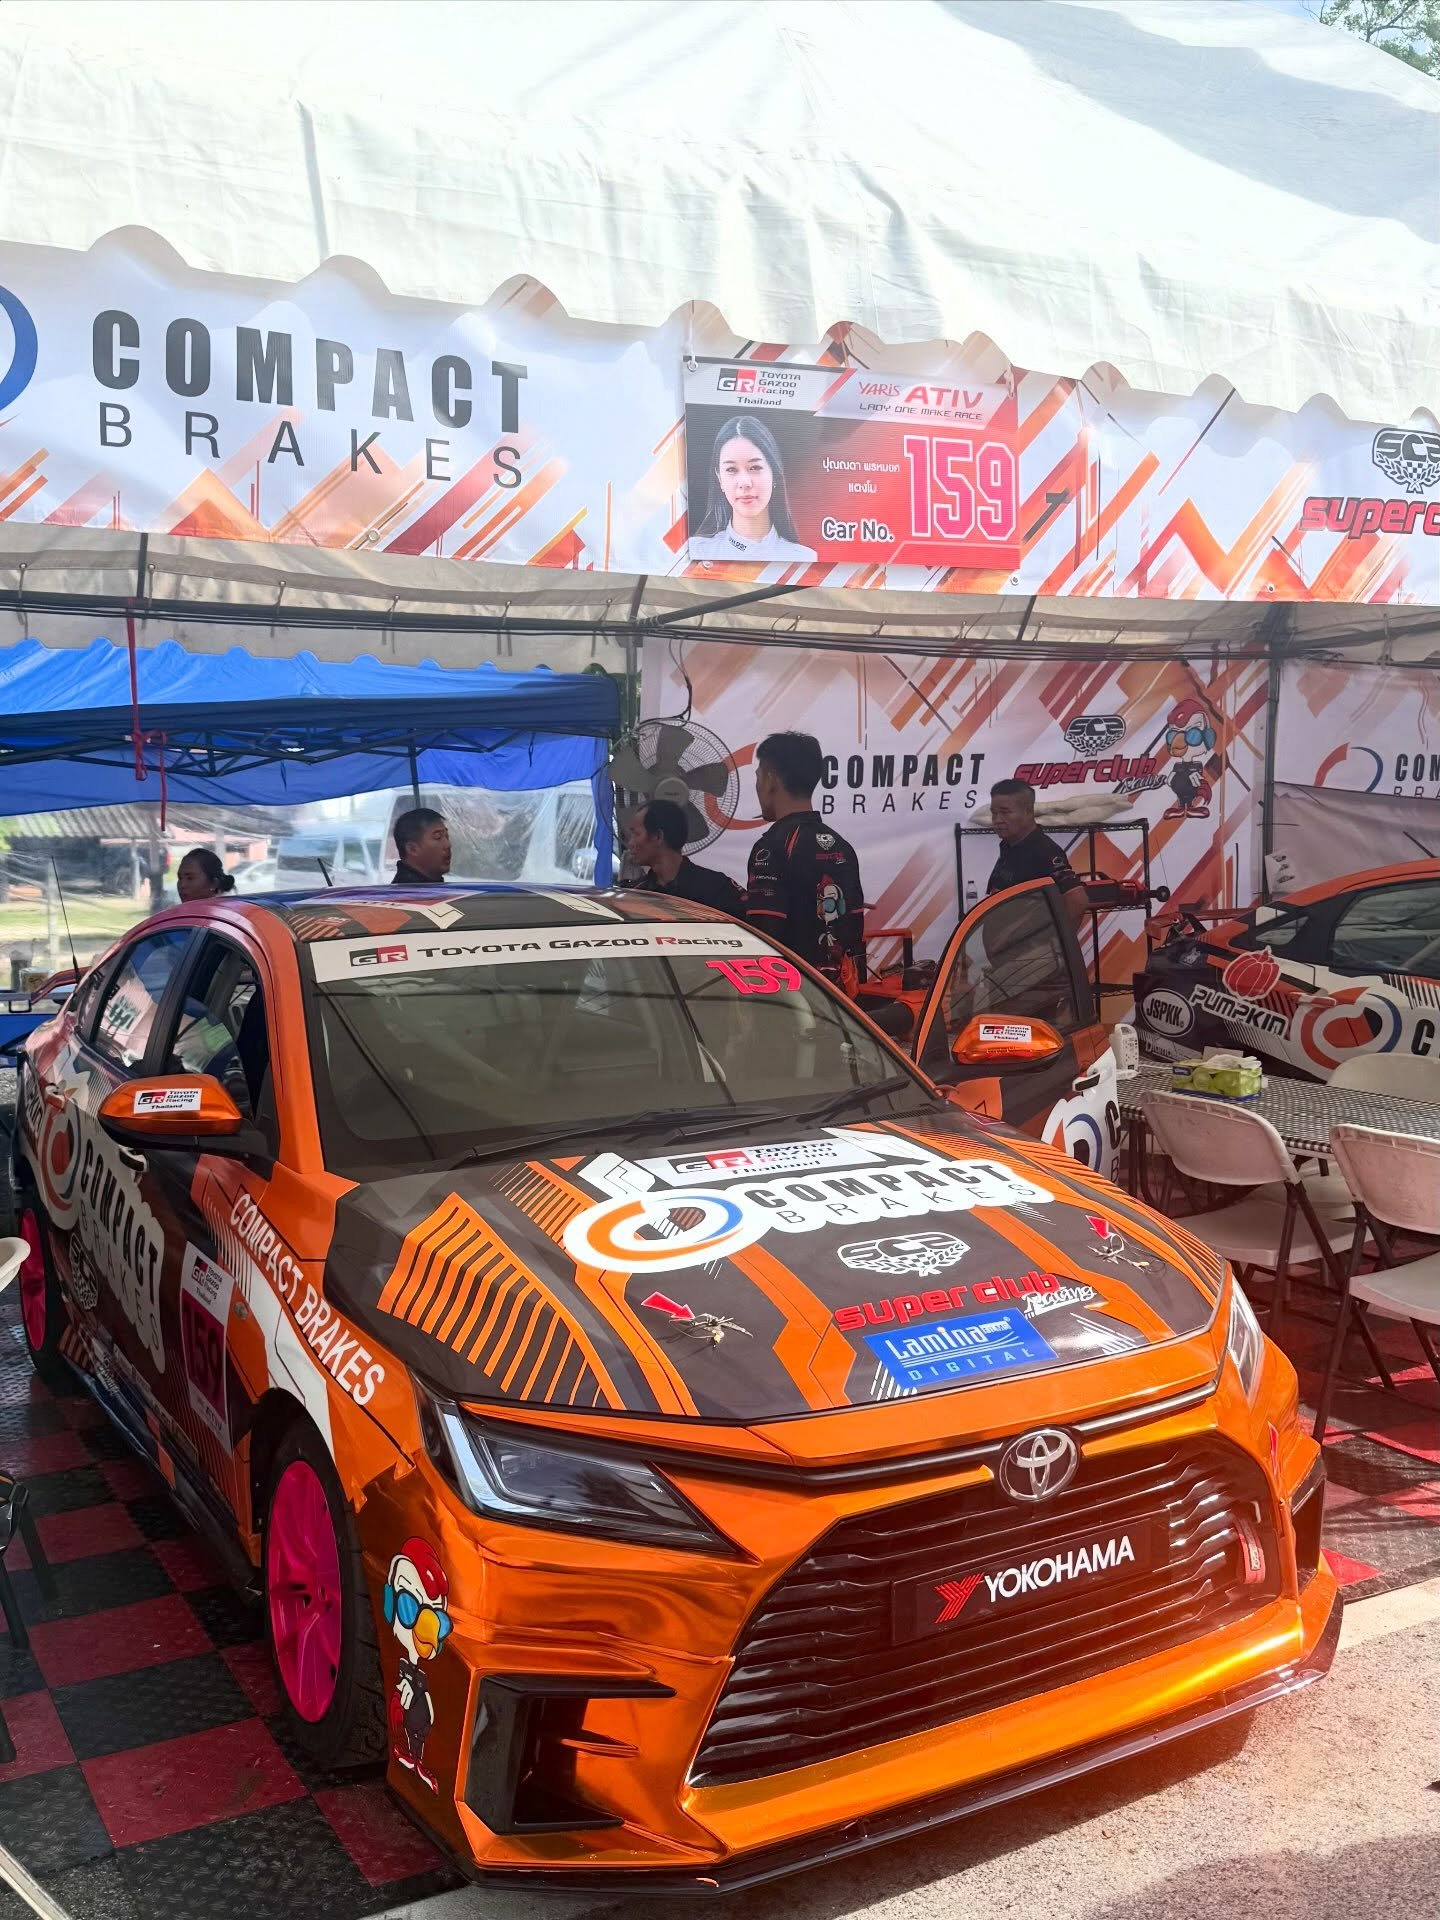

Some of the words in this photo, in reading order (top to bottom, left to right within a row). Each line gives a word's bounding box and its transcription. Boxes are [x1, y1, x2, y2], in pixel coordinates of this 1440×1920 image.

[92, 309, 528, 433] COMPACT
[717, 368, 757, 393] GR
[759, 379, 797, 388] GAZOO
[760, 371, 801, 381] TOYOTA
[737, 396, 782, 406] Thailand
[758, 386, 795, 397] Racing
[904, 386, 984, 409] ATIV
[859, 402, 892, 412] LADY
[895, 405, 917, 414] ONE
[921, 408, 951, 417] MAKE
[955, 411, 983, 421] RACE
[99, 402, 522, 489] BRAKES
[904, 435, 1016, 541] 159
[822, 517, 858, 541] Car
[861, 518, 895, 543] No.
[821, 753, 985, 789] COMPACT
[822, 790, 978, 815] BRAKES
[349, 945, 408, 966] GR
[417, 943, 541, 957] TOYOTA
[549, 938, 649, 949] GAZOO
[655, 936, 743, 948] Racing
[705, 957, 801, 994] 159
[1146, 998, 1183, 1027] JSPKK
[668, 1151, 754, 1174] GR
[744, 1165, 1011, 1208] COMPACT
[776, 1183, 1037, 1224] BRAKES
[80, 1138, 159, 1305] COMPACT
[230, 1193, 304, 1304] COMPACT
[294, 1283, 386, 1406] BRAKES
[1022, 1284, 1097, 1318] Racing
[885, 1325, 989, 1360] Lamina
[908, 1348, 1035, 1381] DIGITAL
[984, 1535, 1136, 1603] YOKOHAMA
